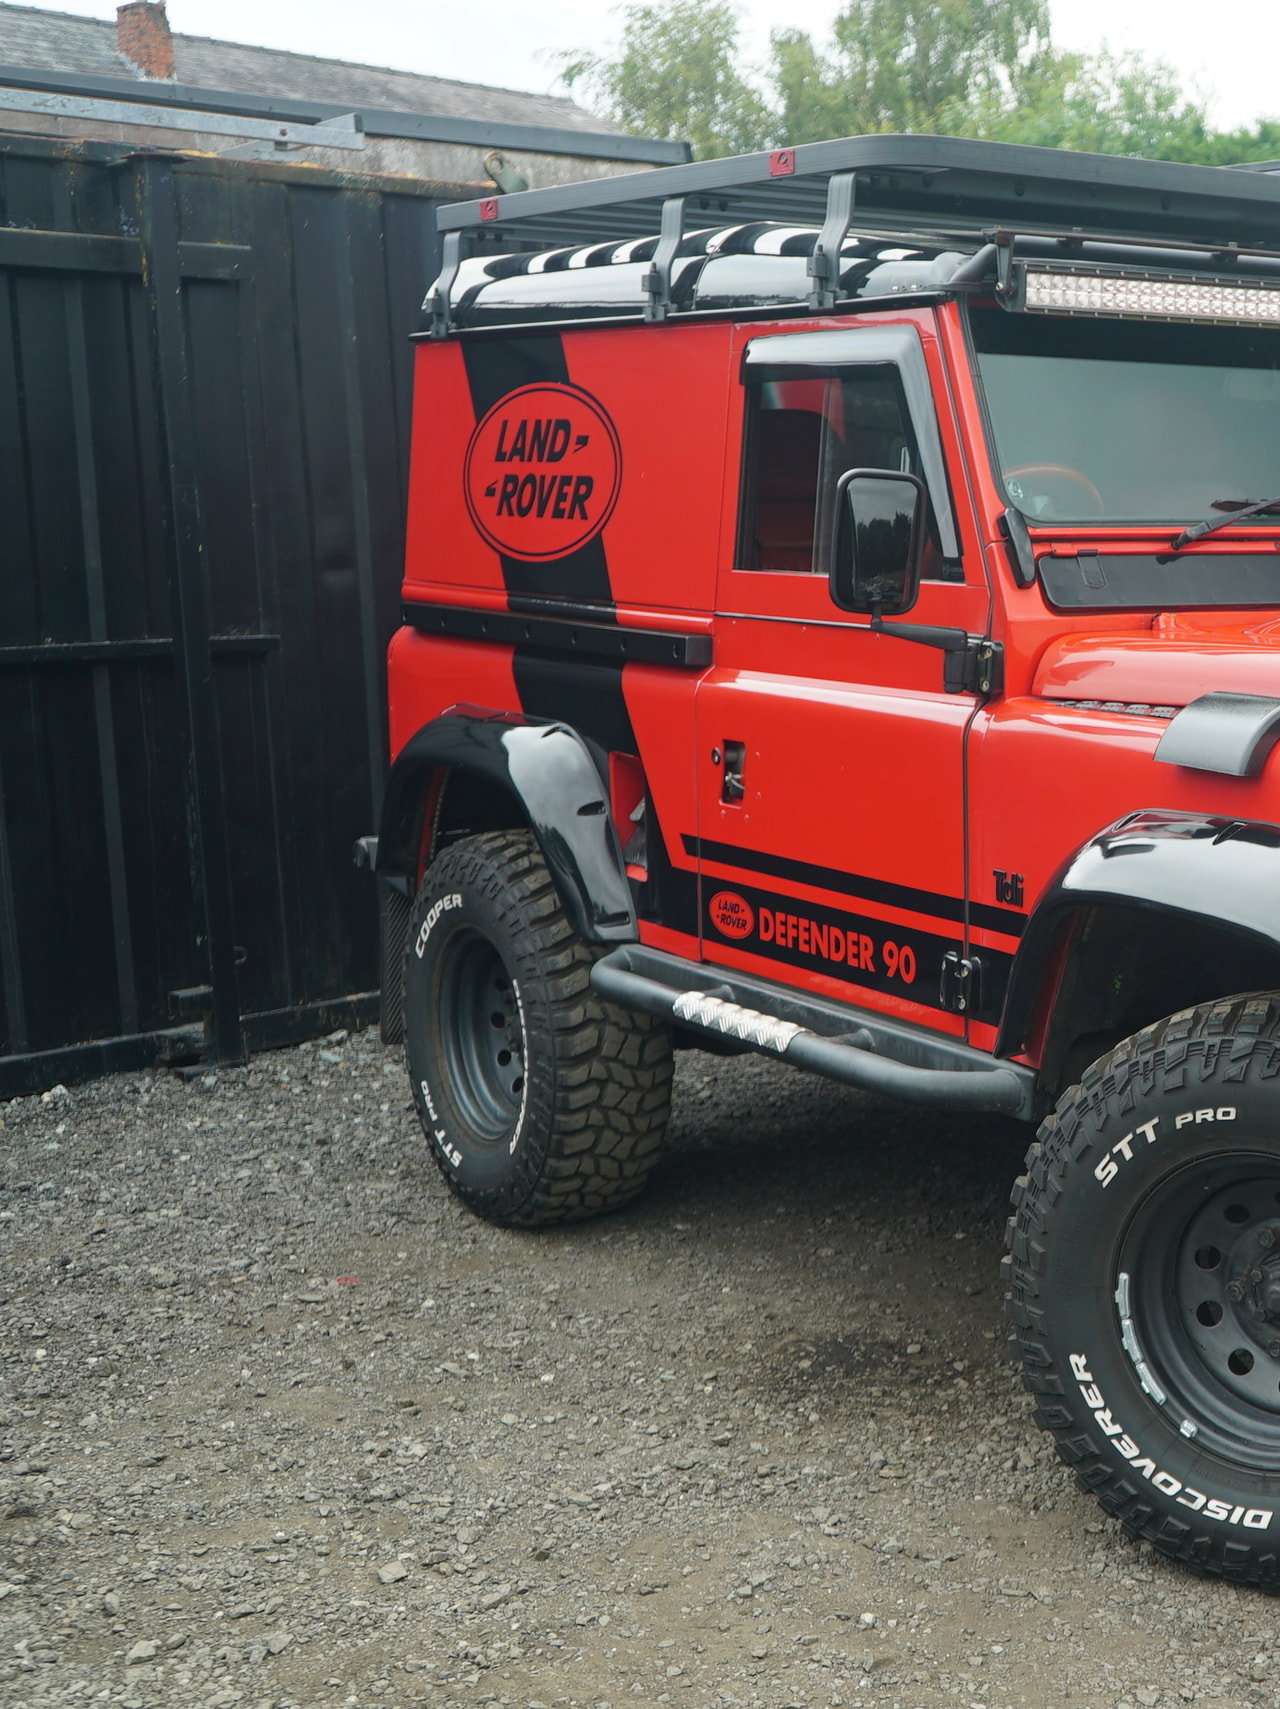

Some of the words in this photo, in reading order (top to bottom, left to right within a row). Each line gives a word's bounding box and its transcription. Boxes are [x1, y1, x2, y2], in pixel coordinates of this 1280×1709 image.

[495, 418, 571, 463] LAND
[496, 473, 594, 521] ROVER
[415, 893, 462, 959] COOPER
[758, 906, 876, 973] DEFENDER
[882, 940, 917, 984] 90
[1094, 1116, 1160, 1189] STT
[1175, 1106, 1237, 1130] PRO
[1069, 1353, 1273, 1530] DISCOVERER
